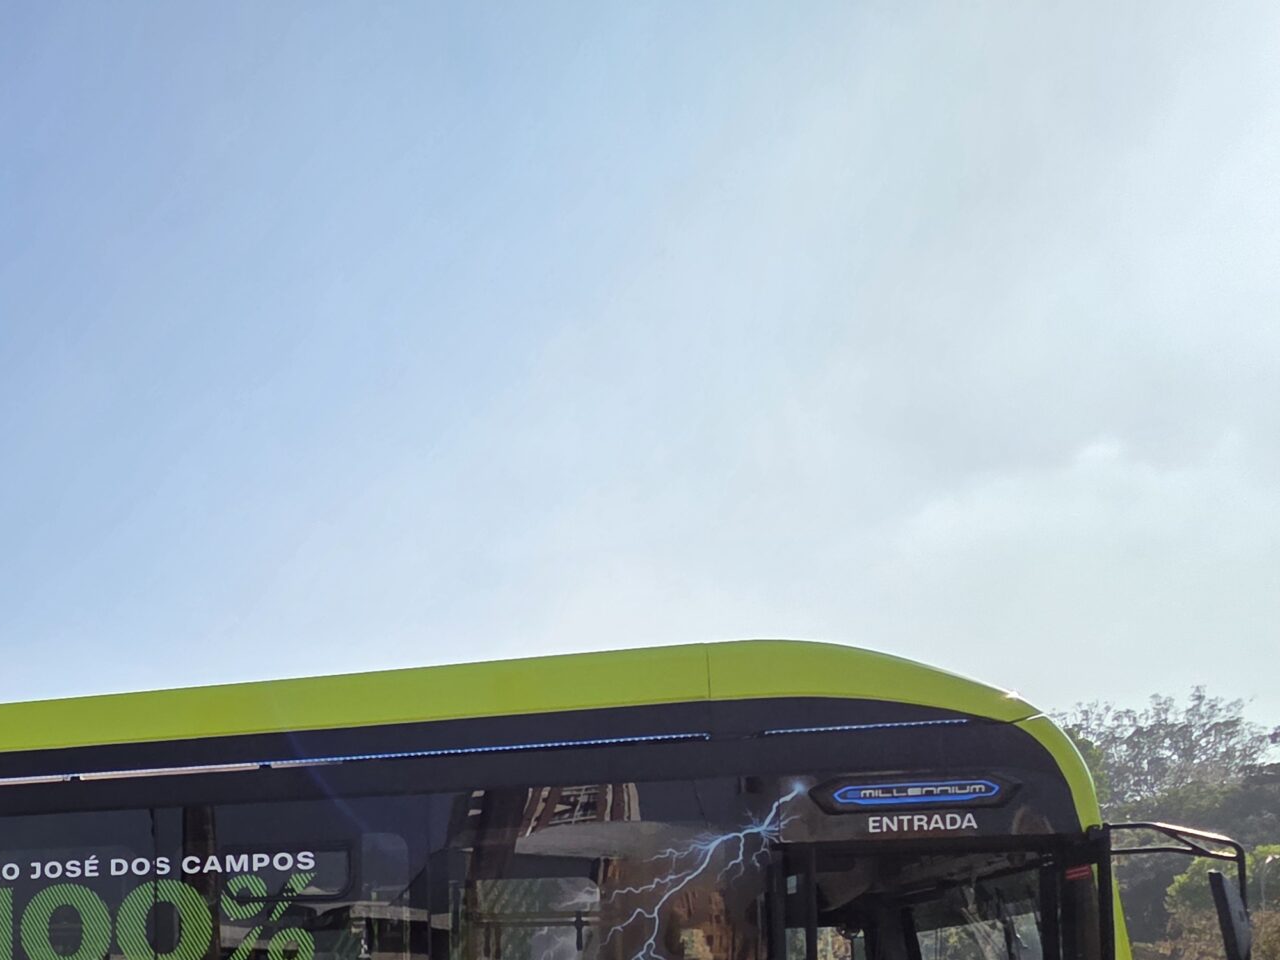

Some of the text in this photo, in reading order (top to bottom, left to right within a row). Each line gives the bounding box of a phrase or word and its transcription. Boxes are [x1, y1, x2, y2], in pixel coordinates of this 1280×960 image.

[868, 813, 978, 833] ENTRADA
[30, 855, 100, 880] JOSÉ
[110, 857, 171, 877] DOS
[182, 851, 316, 874] CAMPOS
